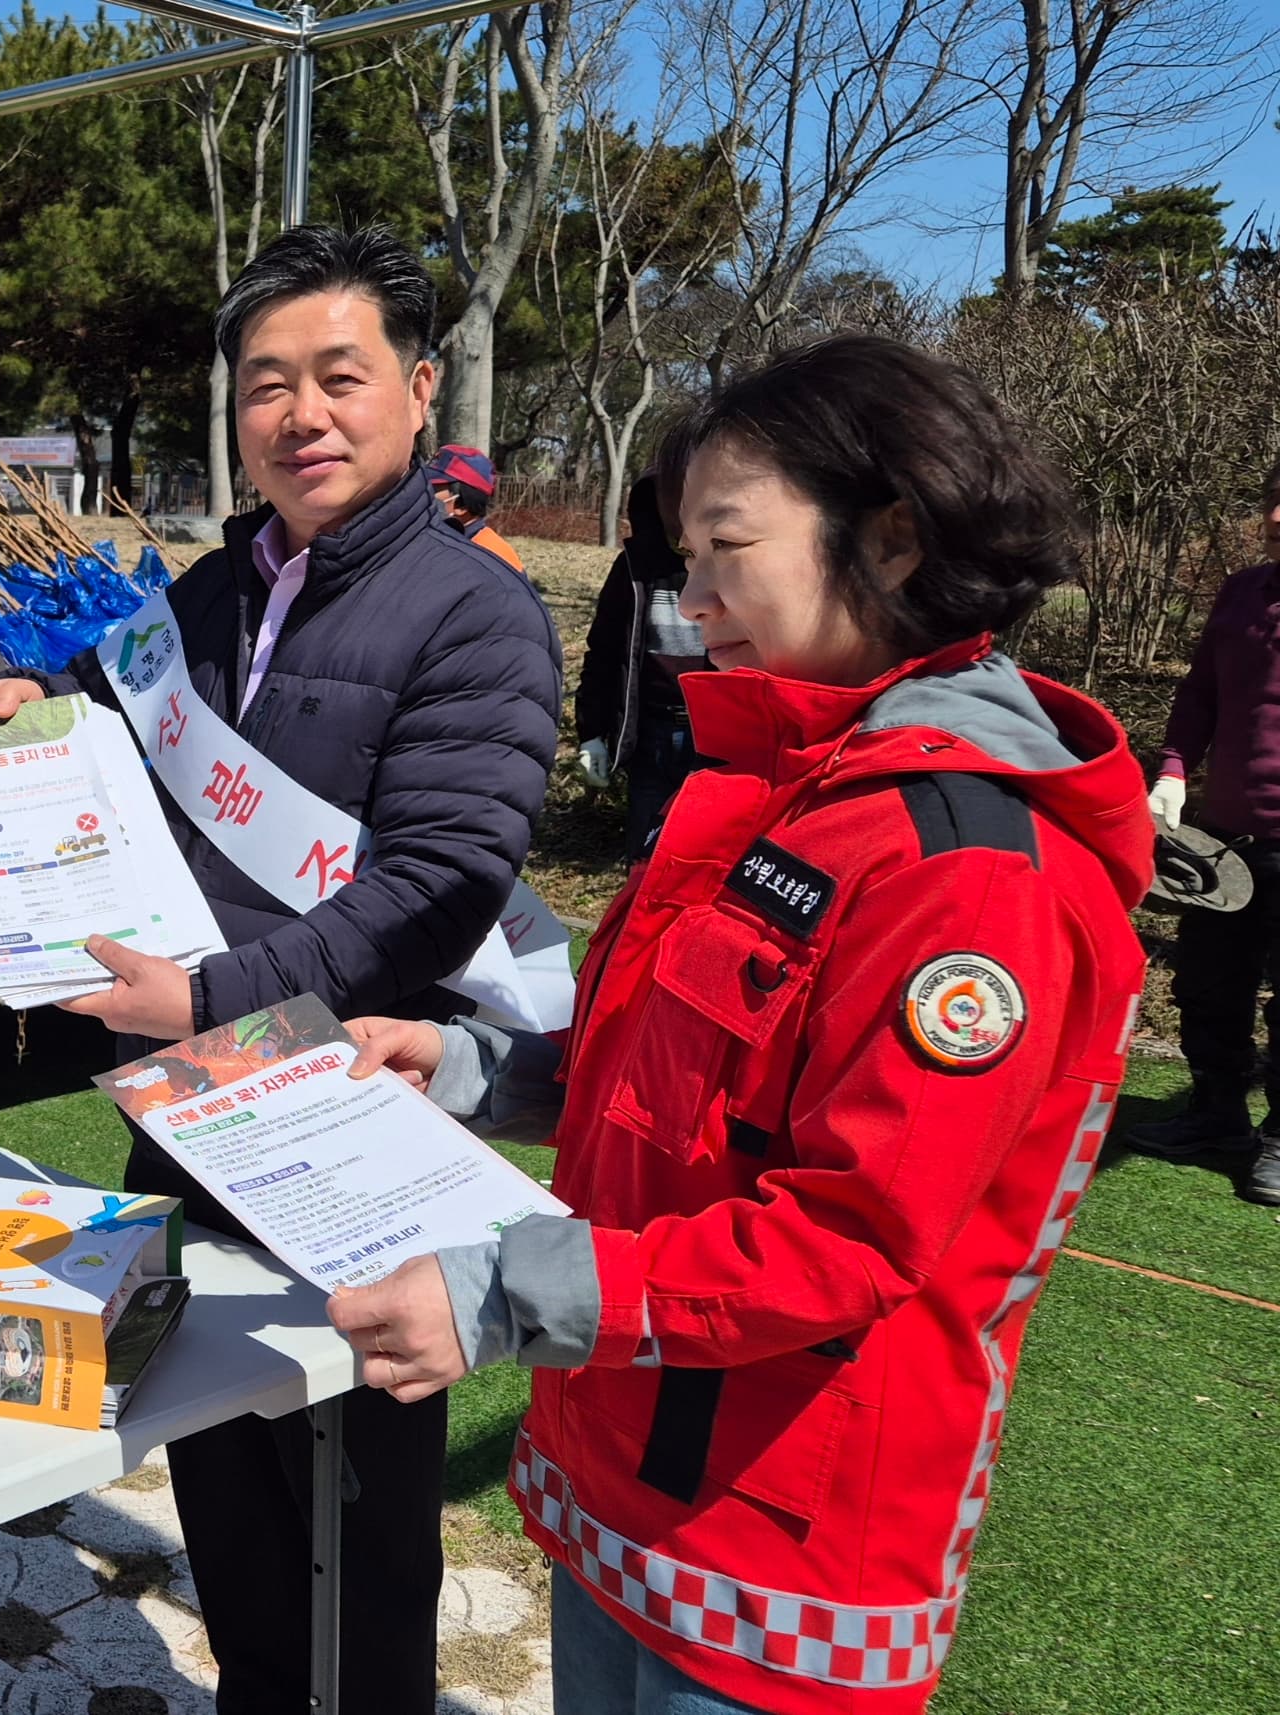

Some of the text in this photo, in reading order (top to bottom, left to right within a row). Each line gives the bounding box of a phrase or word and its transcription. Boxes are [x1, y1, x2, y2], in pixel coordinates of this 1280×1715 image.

[12, 746, 40, 767] 금지
[43, 742, 70, 761] 안내
[743, 856, 821, 914] 산림보호팀장
[919, 973, 947, 1001] KOREA
[165, 1053, 346, 1129] 산불 예방 꼭! 지켜주세요!
[311, 1223, 425, 1275] 이제는 끝내야 합니다!
[347, 1268, 365, 1283] 피해
[365, 1260, 385, 1274] 신고
